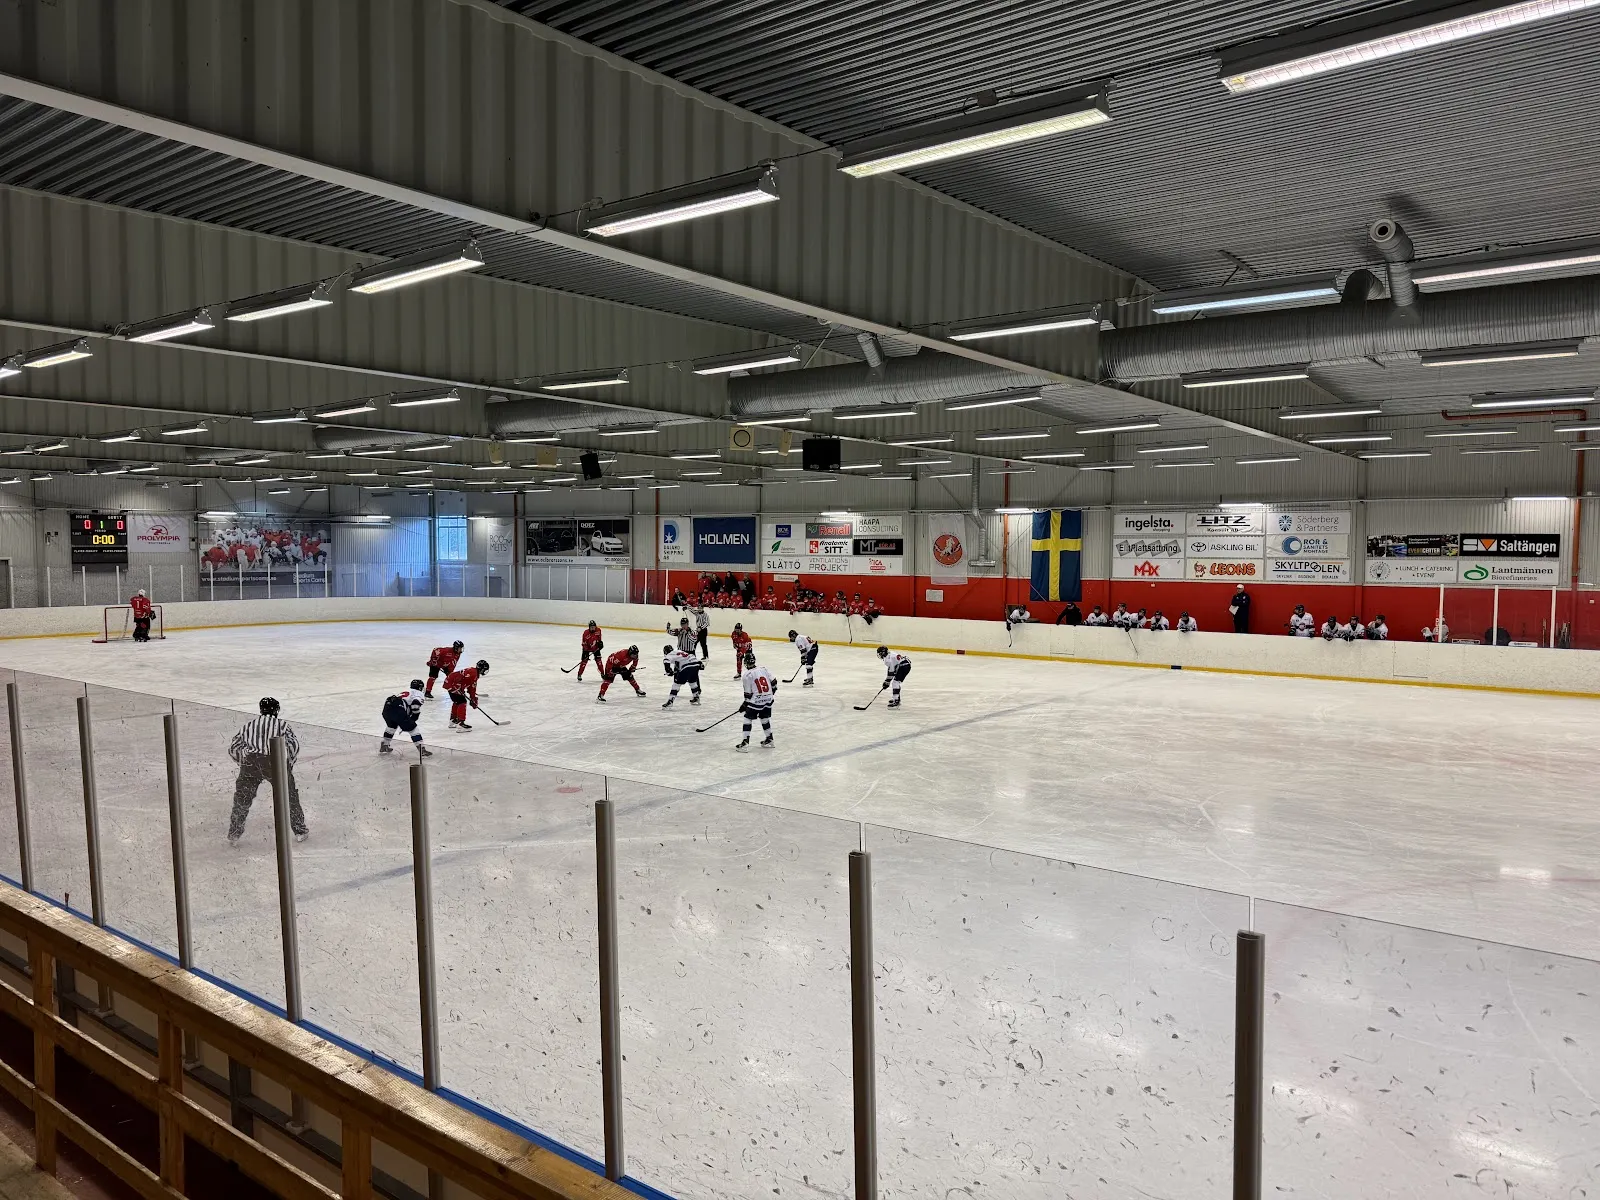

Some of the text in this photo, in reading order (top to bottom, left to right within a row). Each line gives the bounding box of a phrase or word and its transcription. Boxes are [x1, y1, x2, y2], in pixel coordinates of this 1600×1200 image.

[1201, 516, 1246, 524] LITZ
[1297, 515, 1339, 524] Söderberg
[84, 520, 91, 530] 0
[117, 520, 124, 530] 0
[1296, 524, 1338, 532] & Partners
[93, 535, 115, 545] 0:00
[699, 533, 750, 545] HOLMEN
[1500, 540, 1557, 555] Saltängen
[767, 559, 801, 569] SLÄTTÖ
[1134, 560, 1160, 576] MAX
[1275, 561, 1340, 573] SKYLTPOOLEN
[1210, 563, 1256, 576] LEONS
[754, 676, 769, 693] 19
